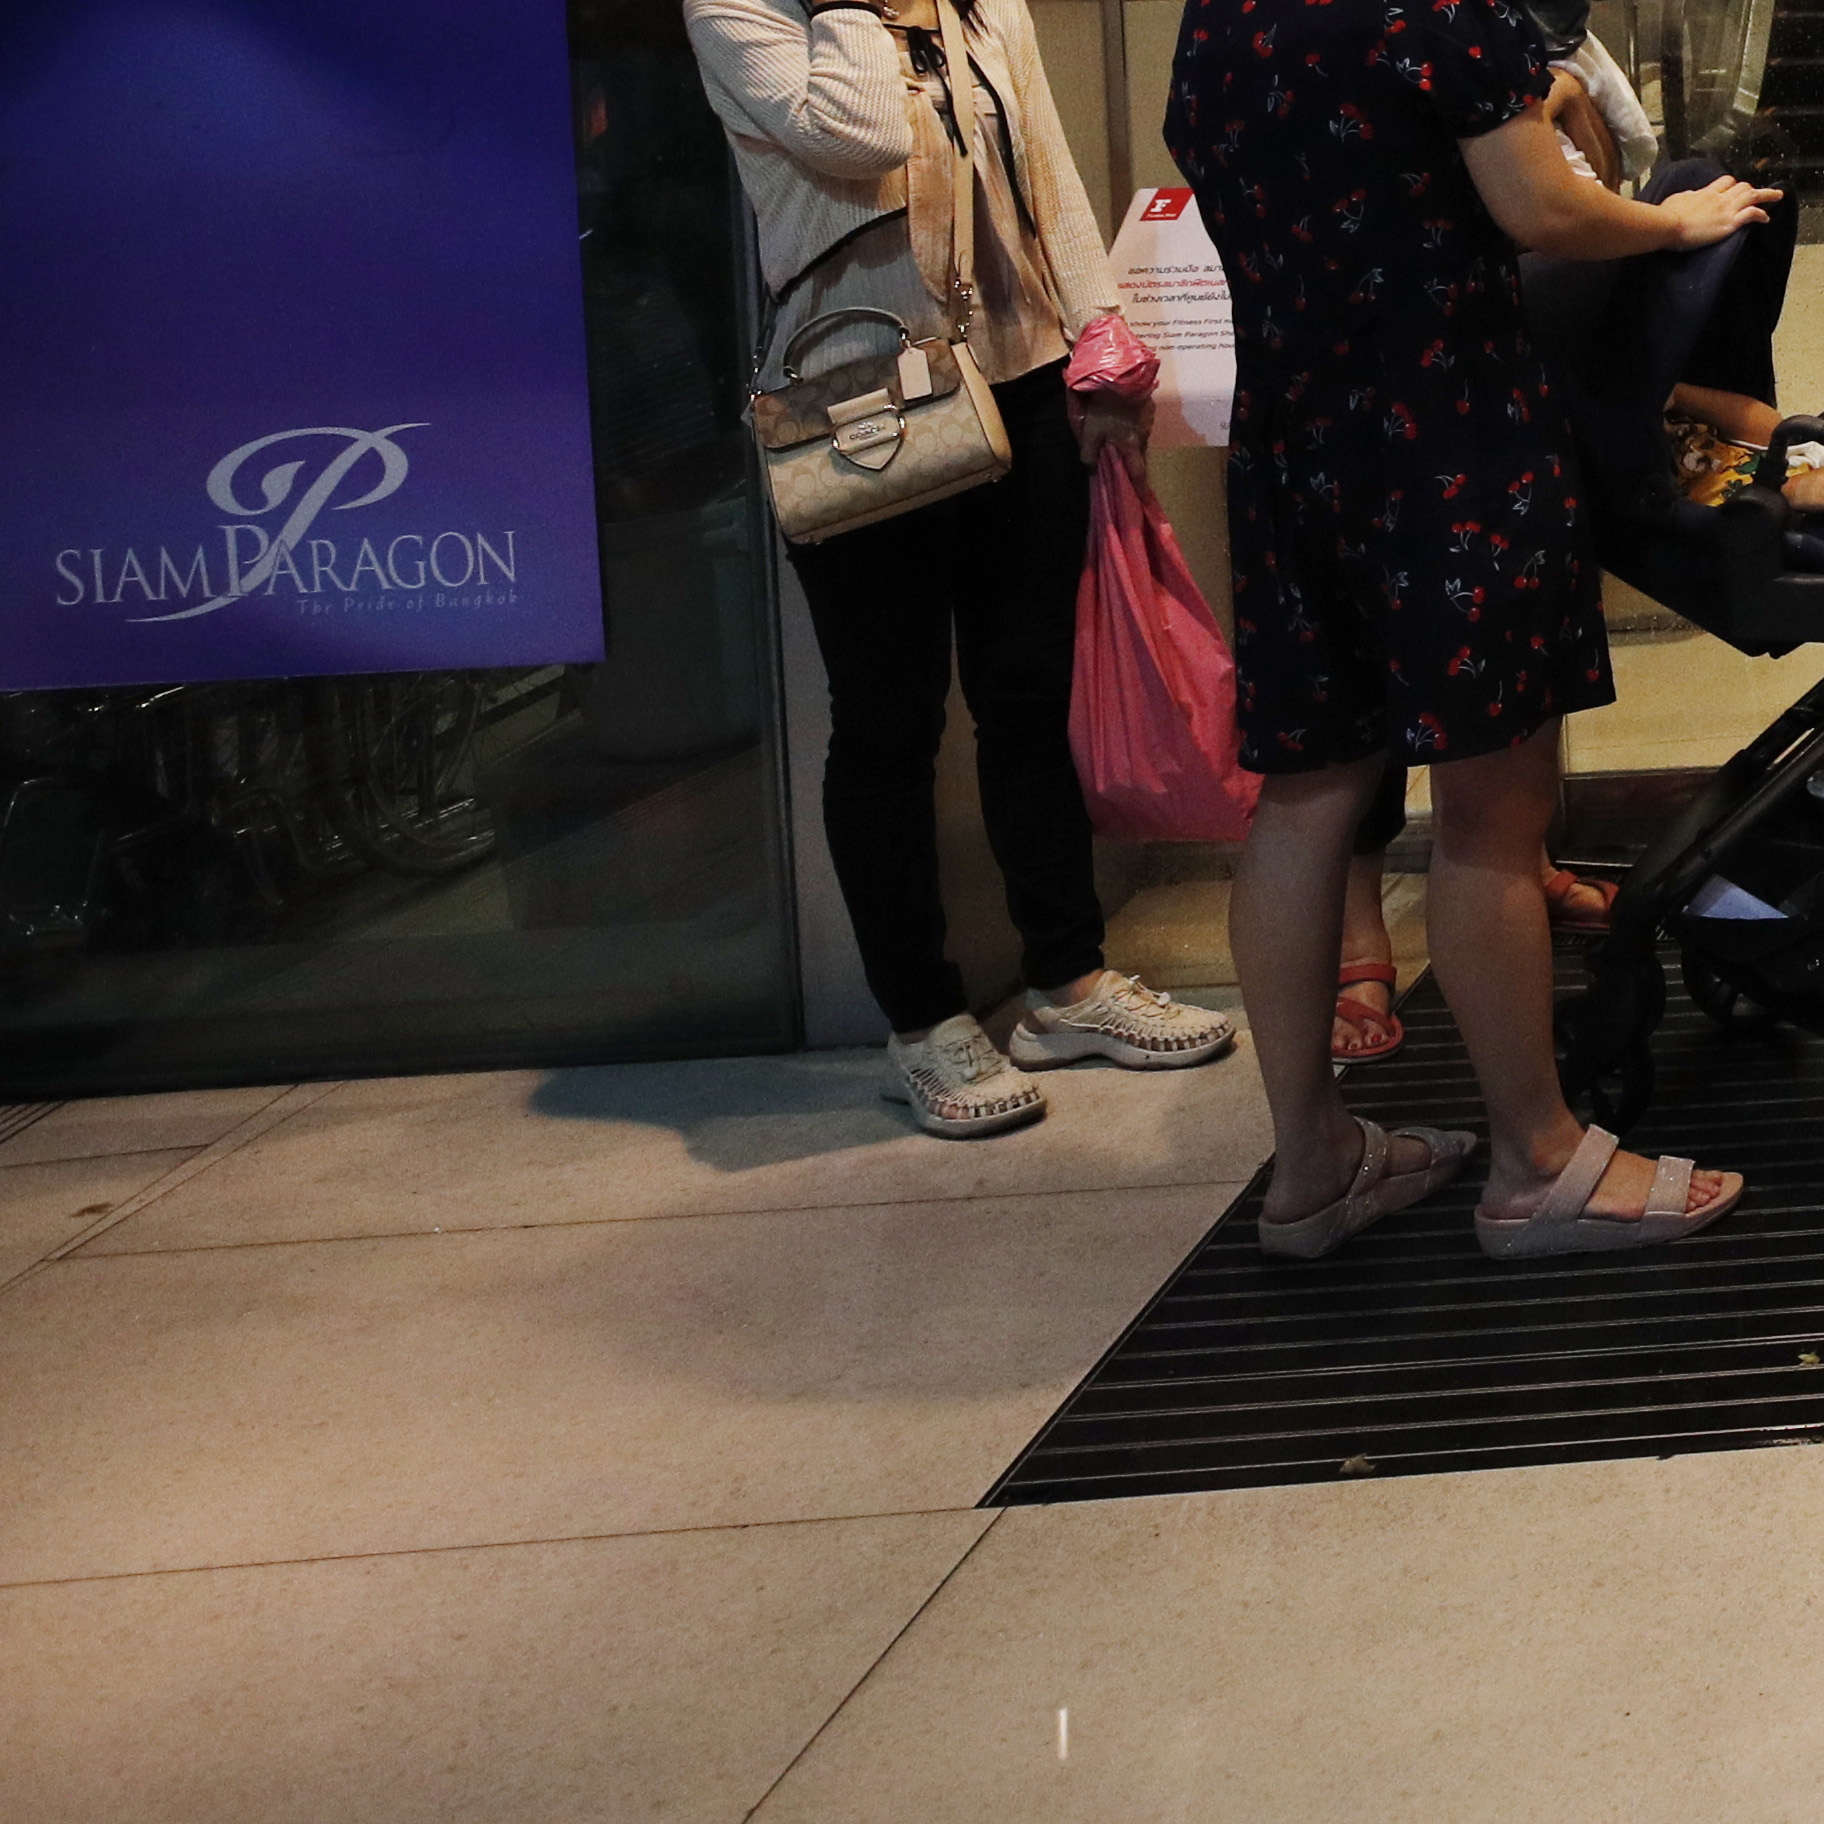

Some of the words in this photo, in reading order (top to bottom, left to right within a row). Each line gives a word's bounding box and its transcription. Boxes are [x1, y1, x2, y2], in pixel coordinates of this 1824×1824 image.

[1150, 199, 1172, 212] F
[1184, 330, 1218, 339] Paragon
[55, 545, 217, 606] SIAM
[343, 595, 395, 613] Pride
[406, 597, 424, 612] of
[435, 588, 519, 611] Bangkok
